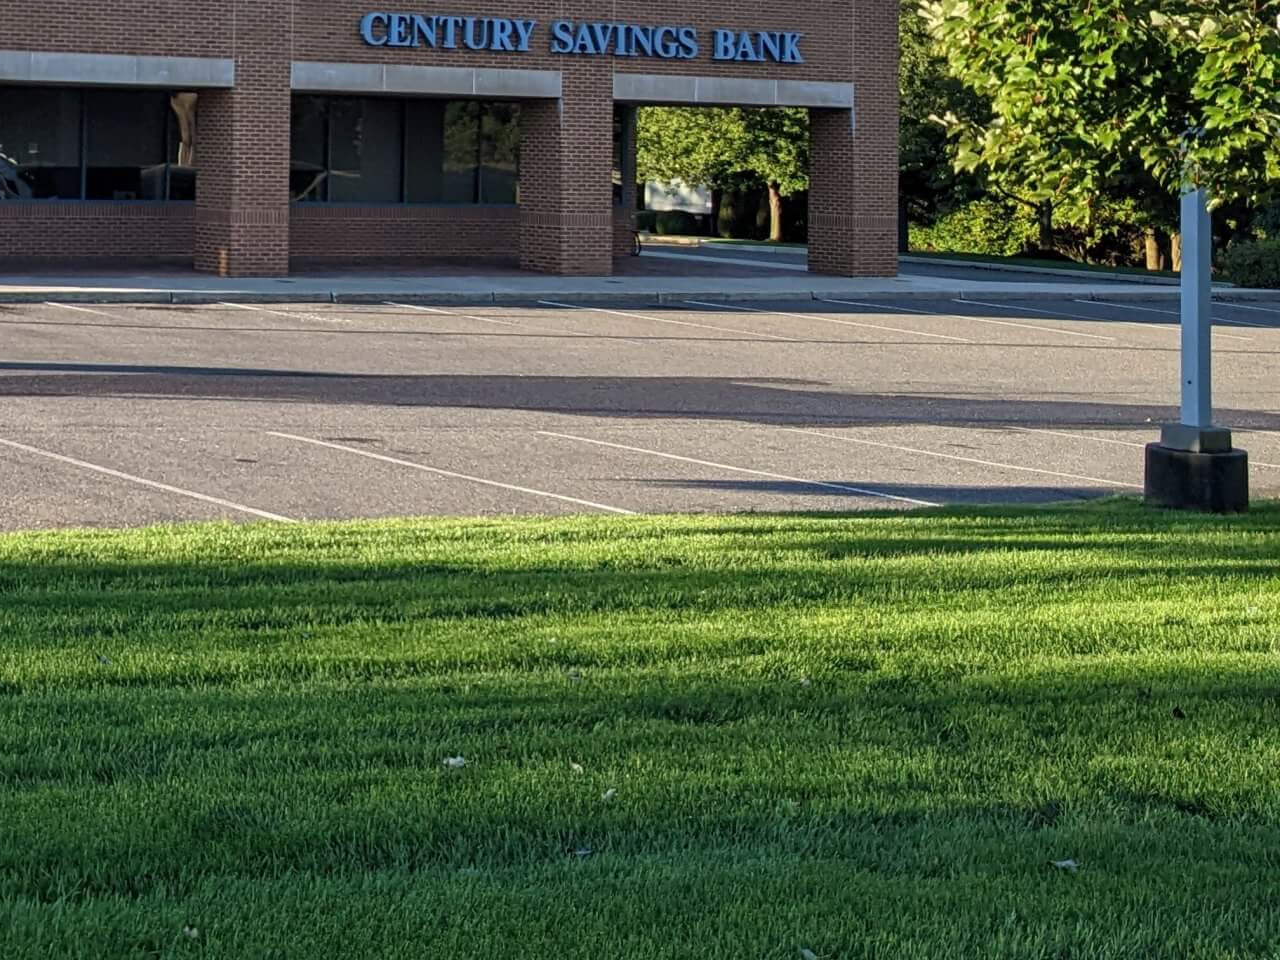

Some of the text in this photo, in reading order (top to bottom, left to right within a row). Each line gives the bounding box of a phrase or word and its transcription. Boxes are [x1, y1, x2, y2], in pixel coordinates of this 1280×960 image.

[361, 11, 805, 63] CENTURY SAVINGS BANK
